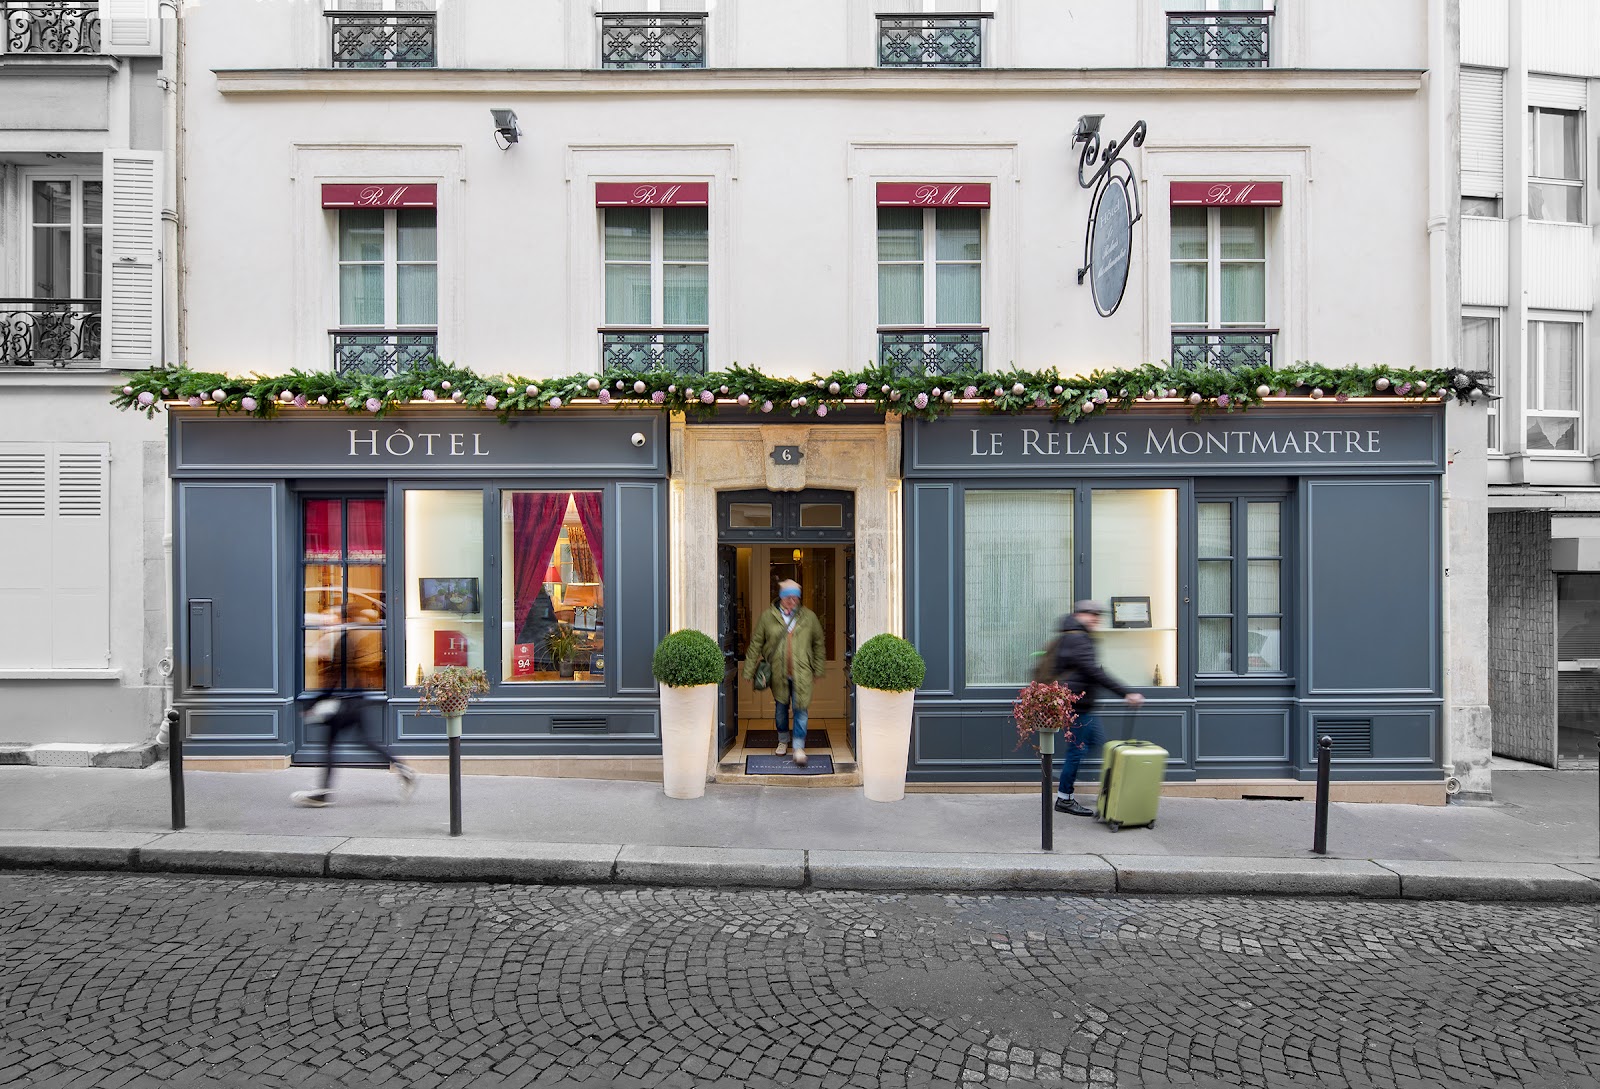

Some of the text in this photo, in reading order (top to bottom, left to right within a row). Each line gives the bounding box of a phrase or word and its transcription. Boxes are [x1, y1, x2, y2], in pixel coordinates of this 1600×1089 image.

[347, 428, 490, 456] HÔTEL
[782, 449, 791, 461] 6
[970, 428, 1381, 456] LE RELAIS MONTMARTRE
